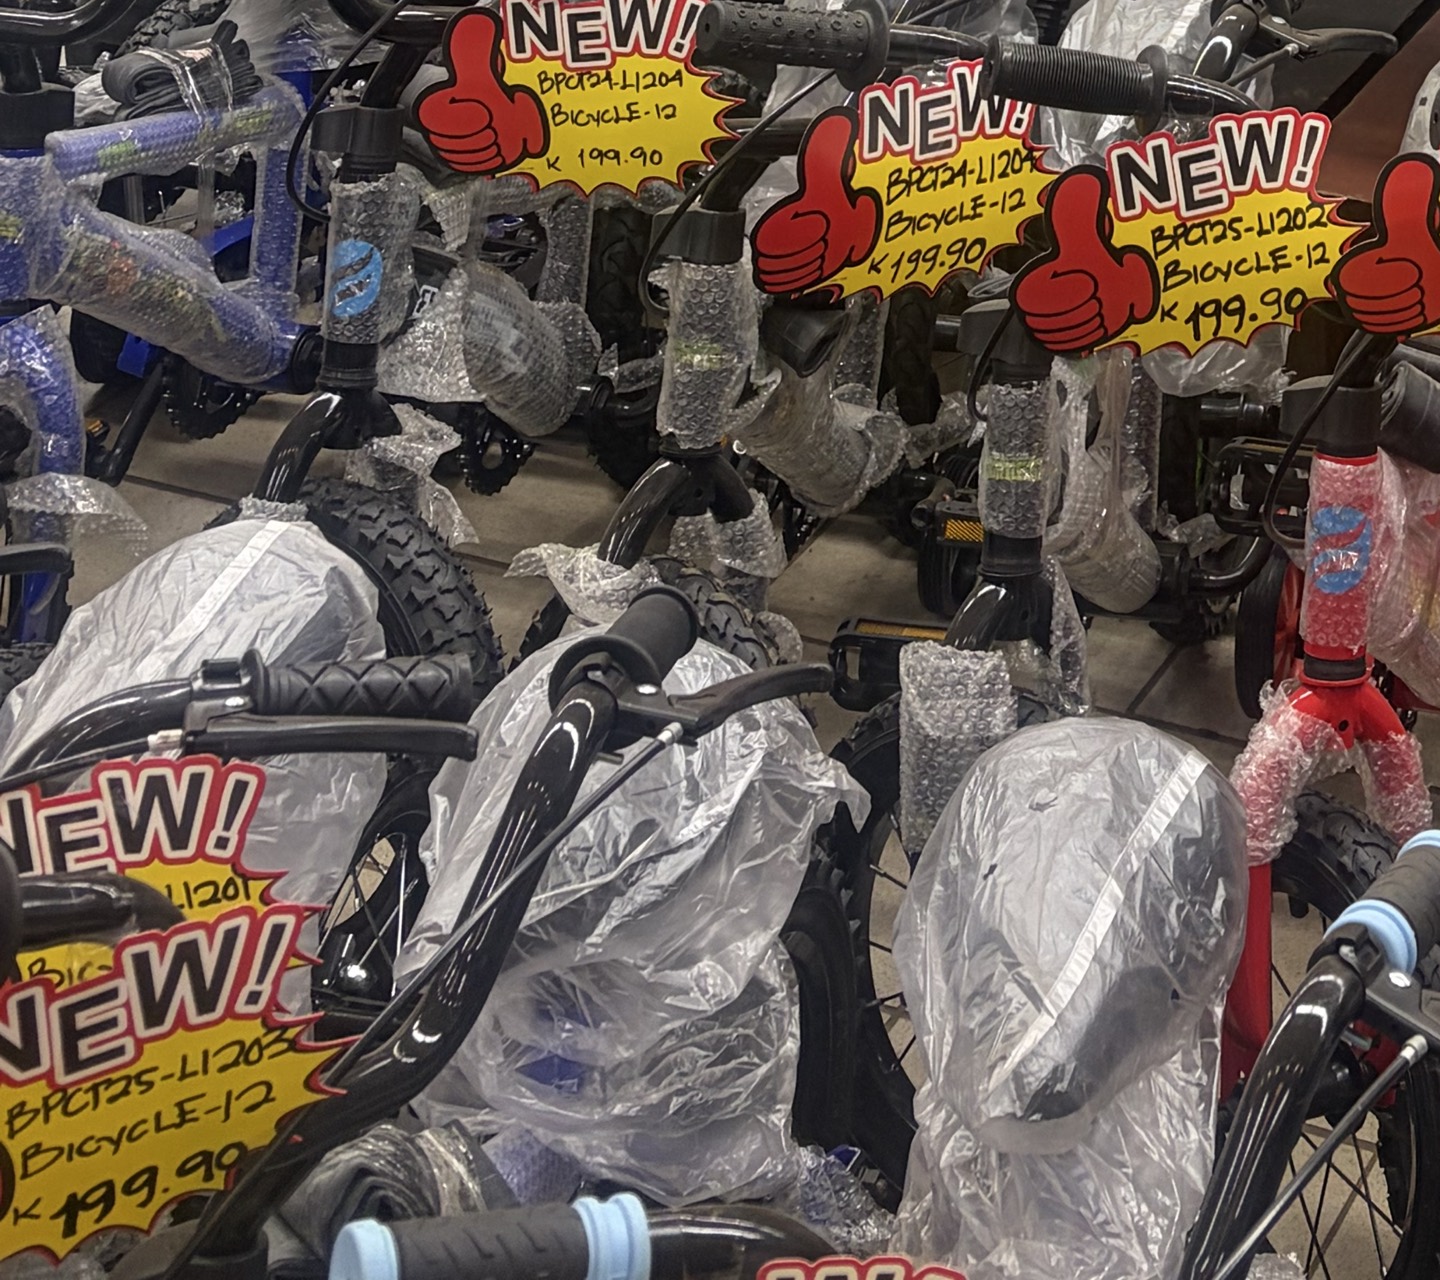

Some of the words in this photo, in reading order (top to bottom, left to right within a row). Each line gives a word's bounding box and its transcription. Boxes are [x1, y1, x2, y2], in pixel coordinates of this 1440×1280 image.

[578, 146, 663, 168] 199.90
[1111, 116, 1324, 217] NEW!
[891, 237, 987, 283] 199.90
[1185, 287, 1309, 341] 199.90
[49, 1141, 249, 1239] 199.90
